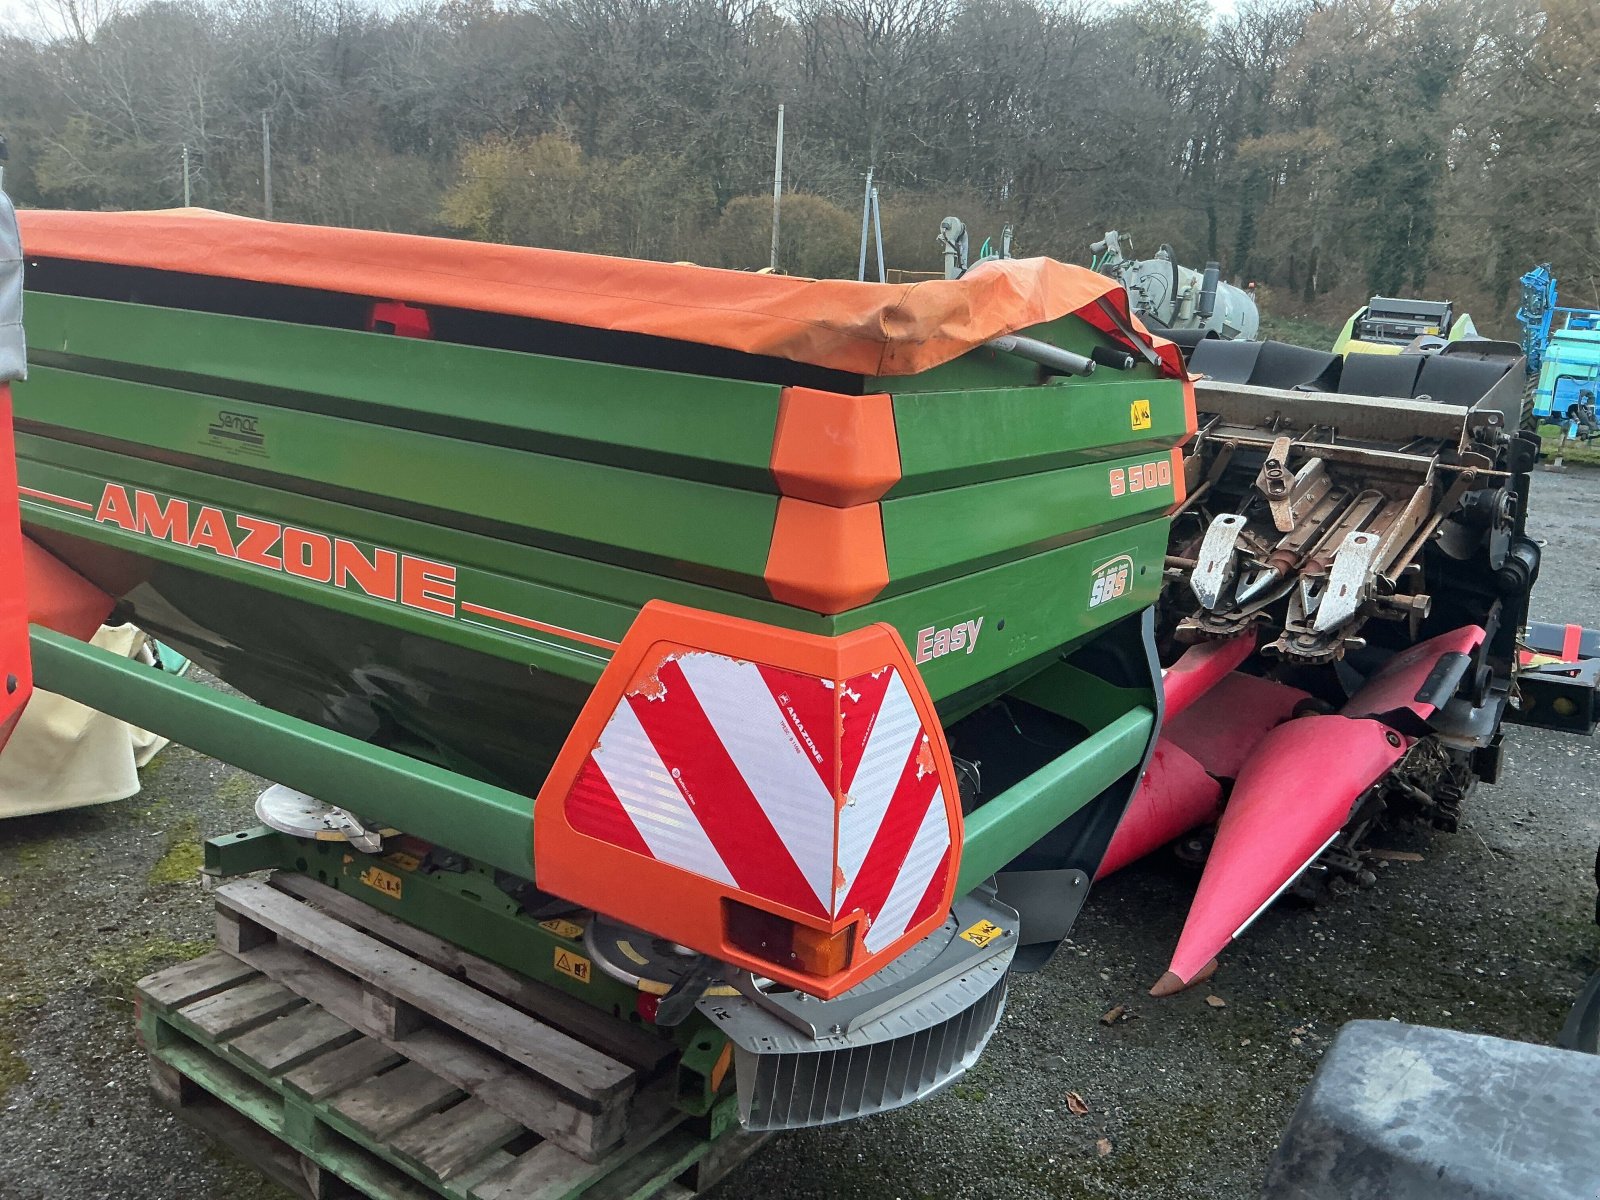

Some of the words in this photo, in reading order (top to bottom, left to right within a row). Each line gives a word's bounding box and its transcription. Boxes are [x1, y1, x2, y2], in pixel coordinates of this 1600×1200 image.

[1110, 468, 1125, 496] S
[1128, 460, 1170, 492] 500
[95, 483, 456, 618] AMAZONE
[1090, 569, 1128, 607] SBS
[916, 616, 984, 665] Easy
[787, 706, 823, 764] AMAZONE
